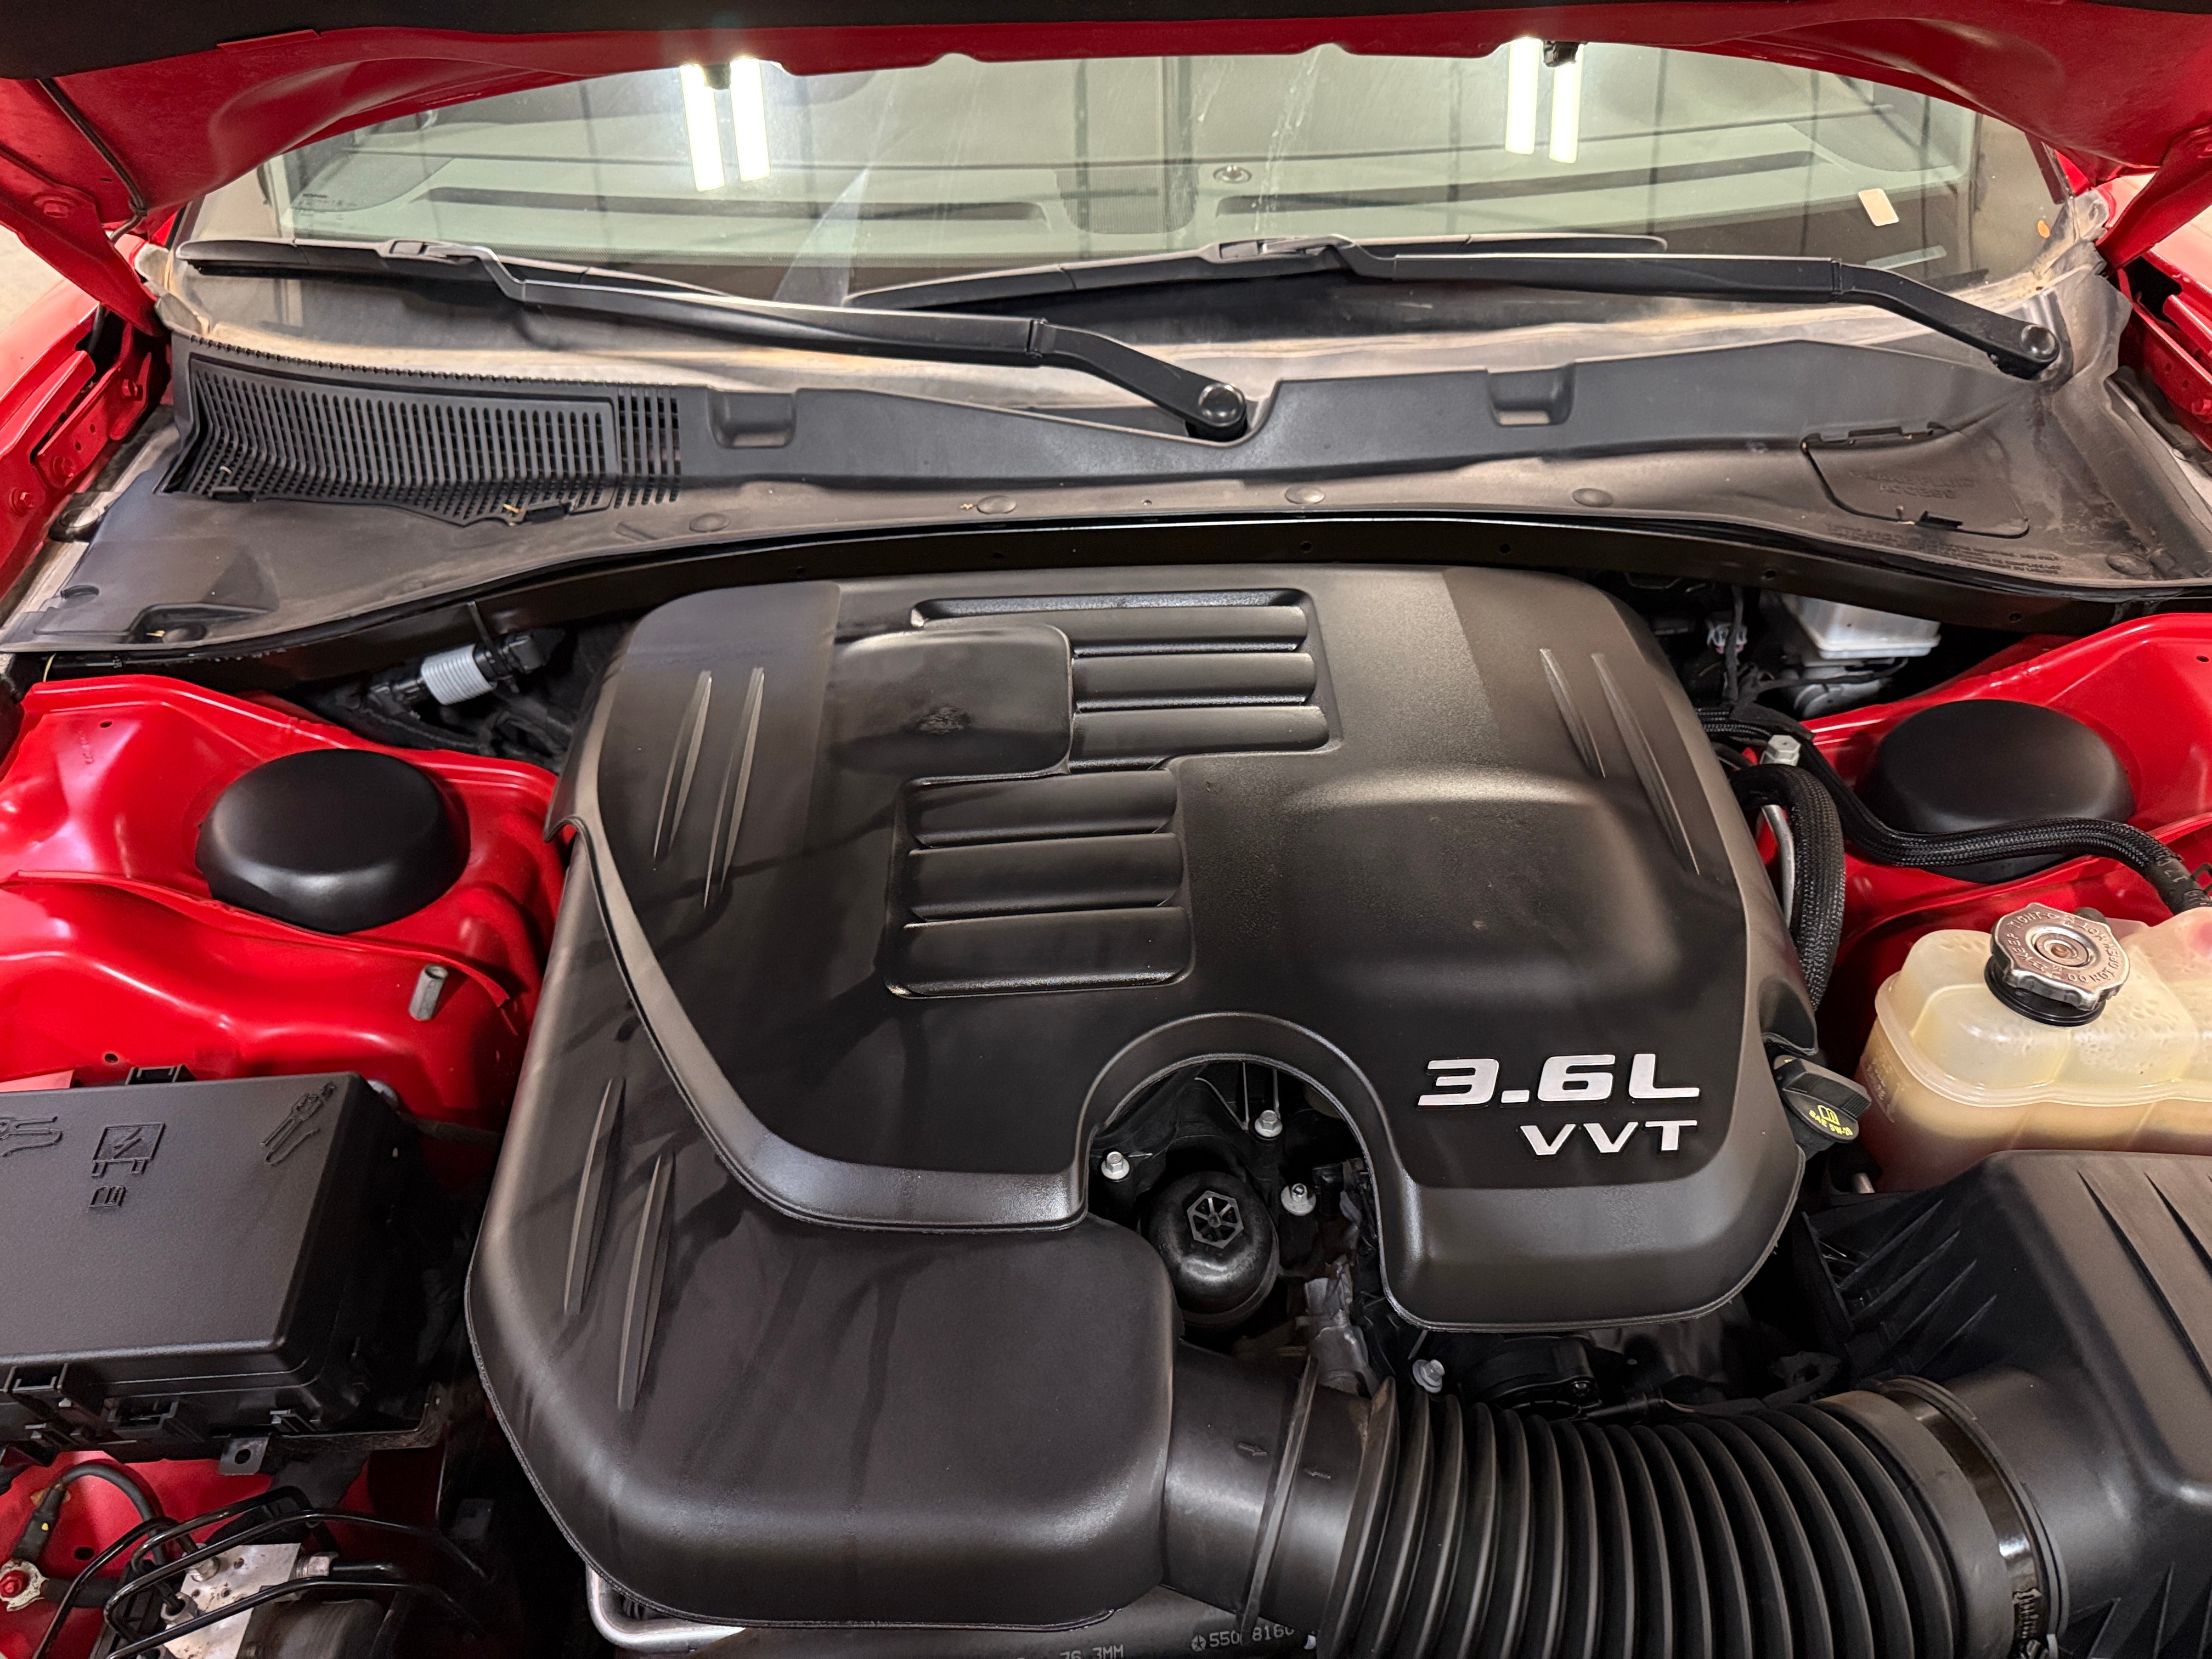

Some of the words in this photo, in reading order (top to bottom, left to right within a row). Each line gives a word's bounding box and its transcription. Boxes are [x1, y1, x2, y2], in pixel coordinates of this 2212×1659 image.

[2006, 933, 2029, 961] KEEP
[2066, 973, 2088, 984] DO
[2089, 969, 2115, 983] NOT
[1417, 1053, 1701, 1107] 3.6L
[1809, 1110, 1827, 1127] SAE
[1520, 1120, 1698, 1156] VVT
